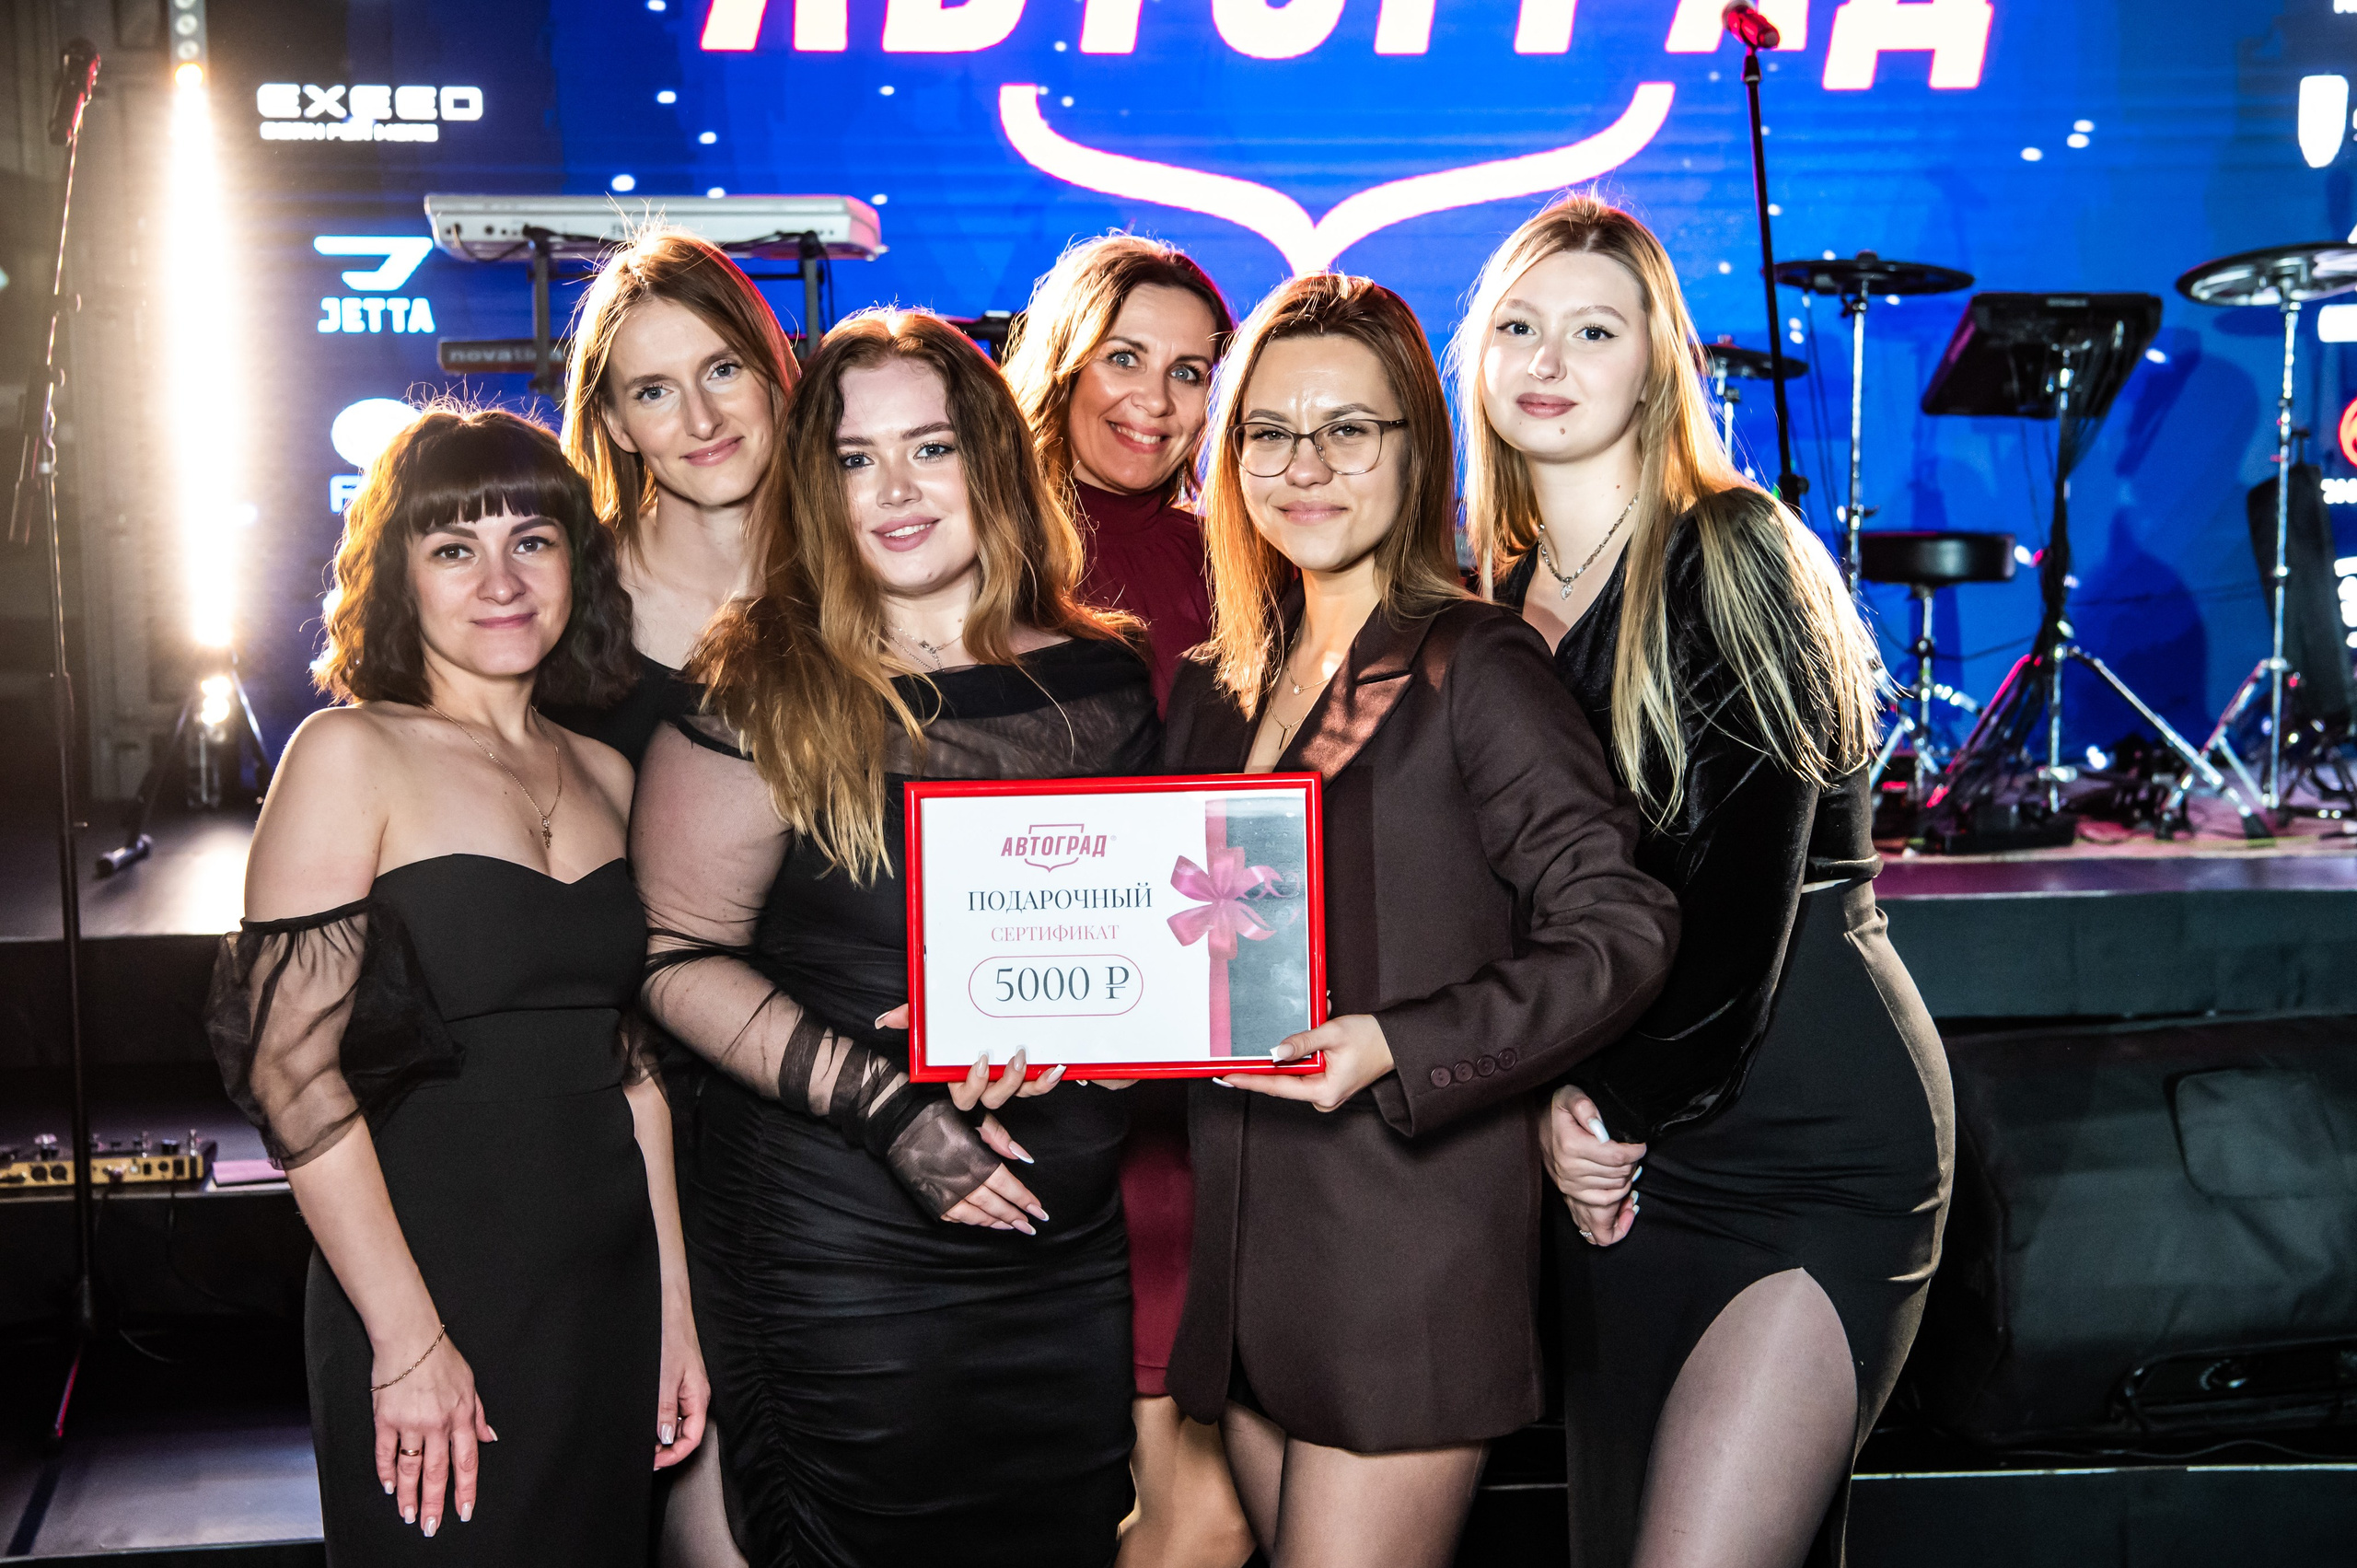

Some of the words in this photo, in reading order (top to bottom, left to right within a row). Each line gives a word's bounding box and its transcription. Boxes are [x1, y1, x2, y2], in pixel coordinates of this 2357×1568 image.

[257, 83, 483, 121] EXEED
[317, 296, 435, 333] JETTA
[1001, 835, 1107, 857] АВТОГРАД
[969, 882, 1152, 913] ПОДАРОЧНЫЙ
[992, 925, 1119, 942] СЕРТИФИКАТ
[996, 967, 1090, 1002] 5000
